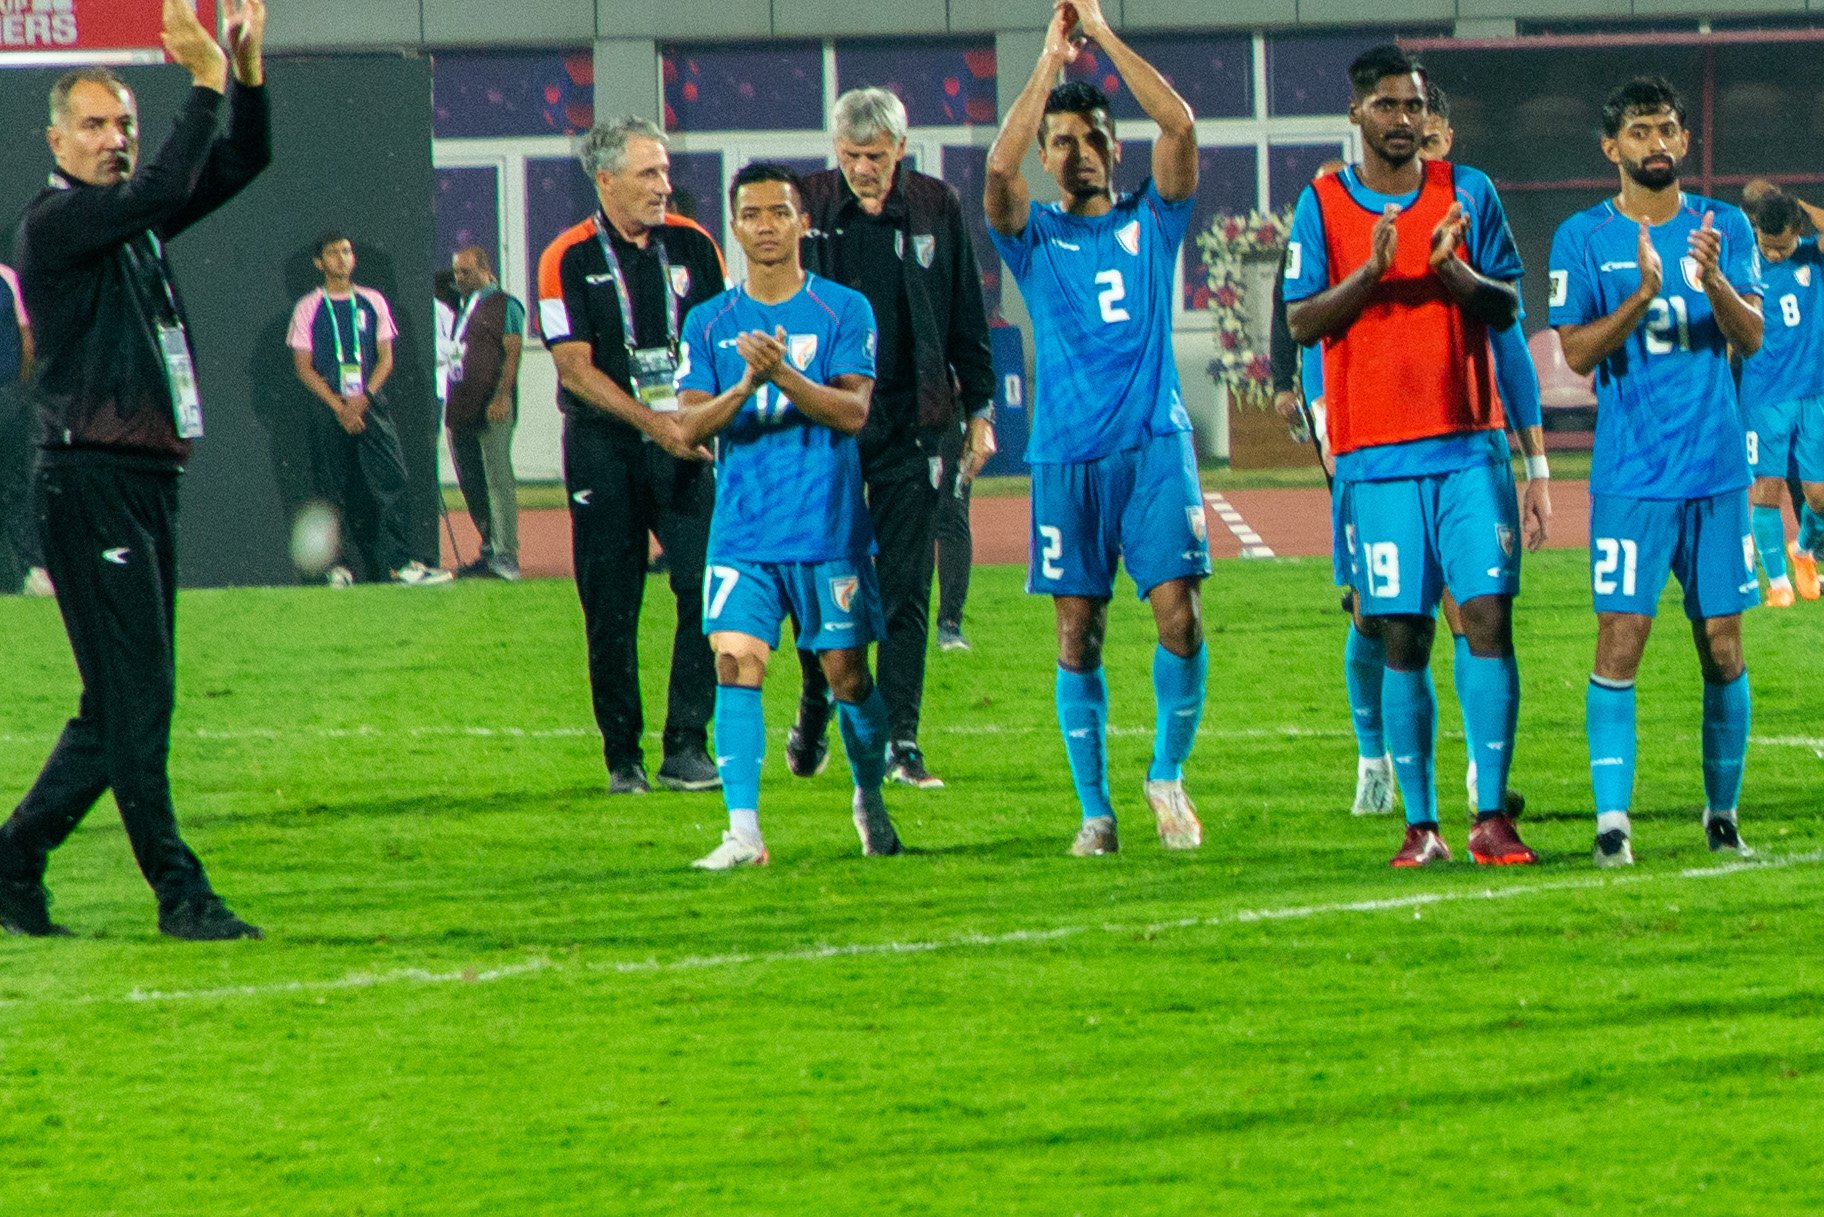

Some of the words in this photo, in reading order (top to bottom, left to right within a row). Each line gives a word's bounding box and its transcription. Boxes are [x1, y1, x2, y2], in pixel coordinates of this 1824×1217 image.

[0, 14, 78, 46] ERS
[1094, 269, 1131, 323] 2
[1779, 293, 1801, 328] 8
[1645, 295, 1690, 355] 21
[1746, 431, 1759, 465] 8
[1039, 525, 1064, 580] 2
[1363, 541, 1400, 598] 19
[1594, 537, 1637, 596] 21
[704, 565, 740, 620] 17
